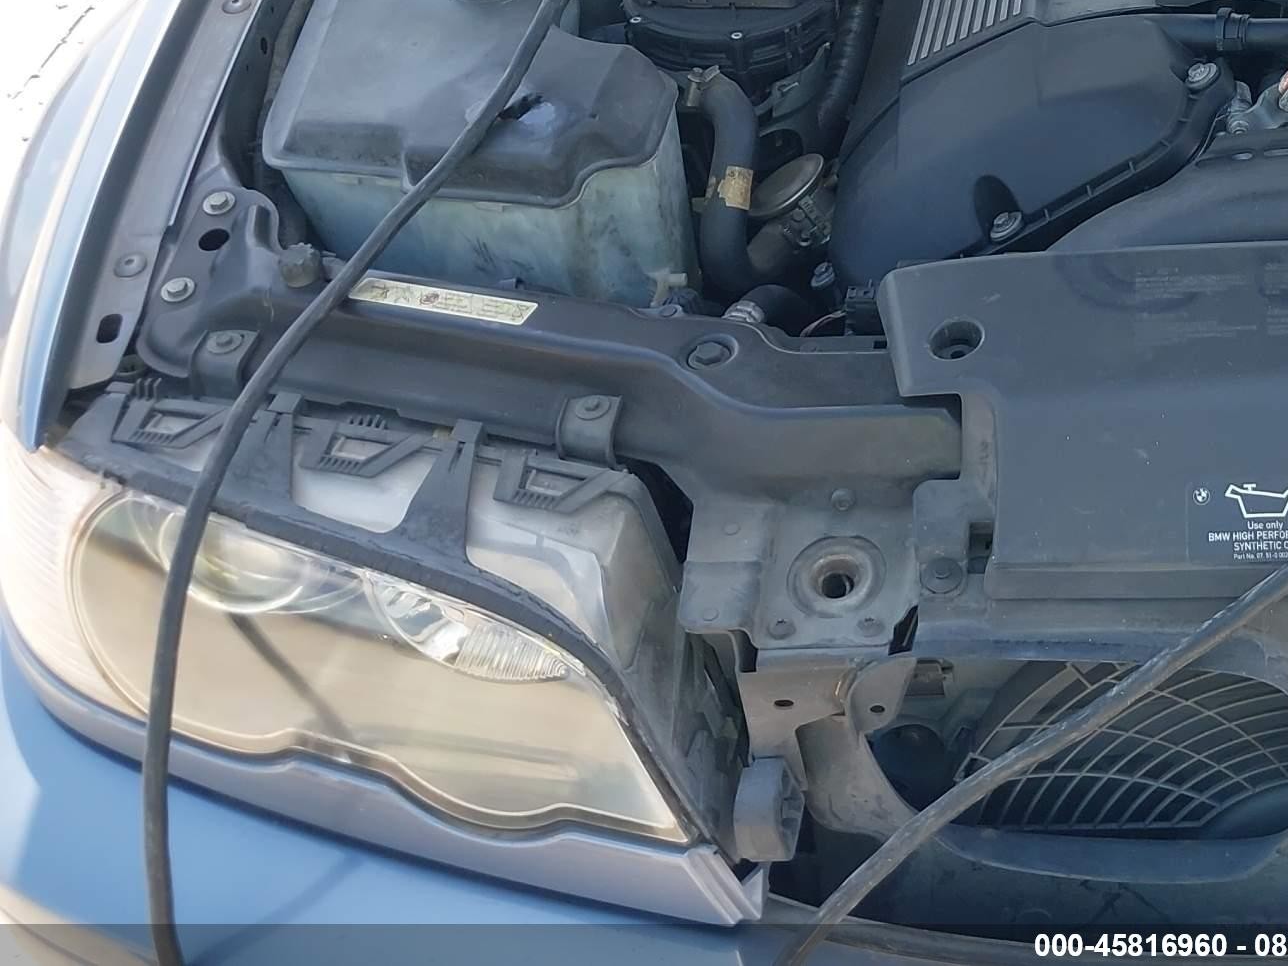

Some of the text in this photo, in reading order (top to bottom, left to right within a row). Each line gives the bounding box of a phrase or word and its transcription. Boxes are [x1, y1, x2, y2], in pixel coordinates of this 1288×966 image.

[1247, 520, 1283, 531] Use only
[1208, 532, 1230, 542] BMW
[1232, 531, 1254, 541] HIGH
[1233, 541, 1281, 551] SYNTHETIC
